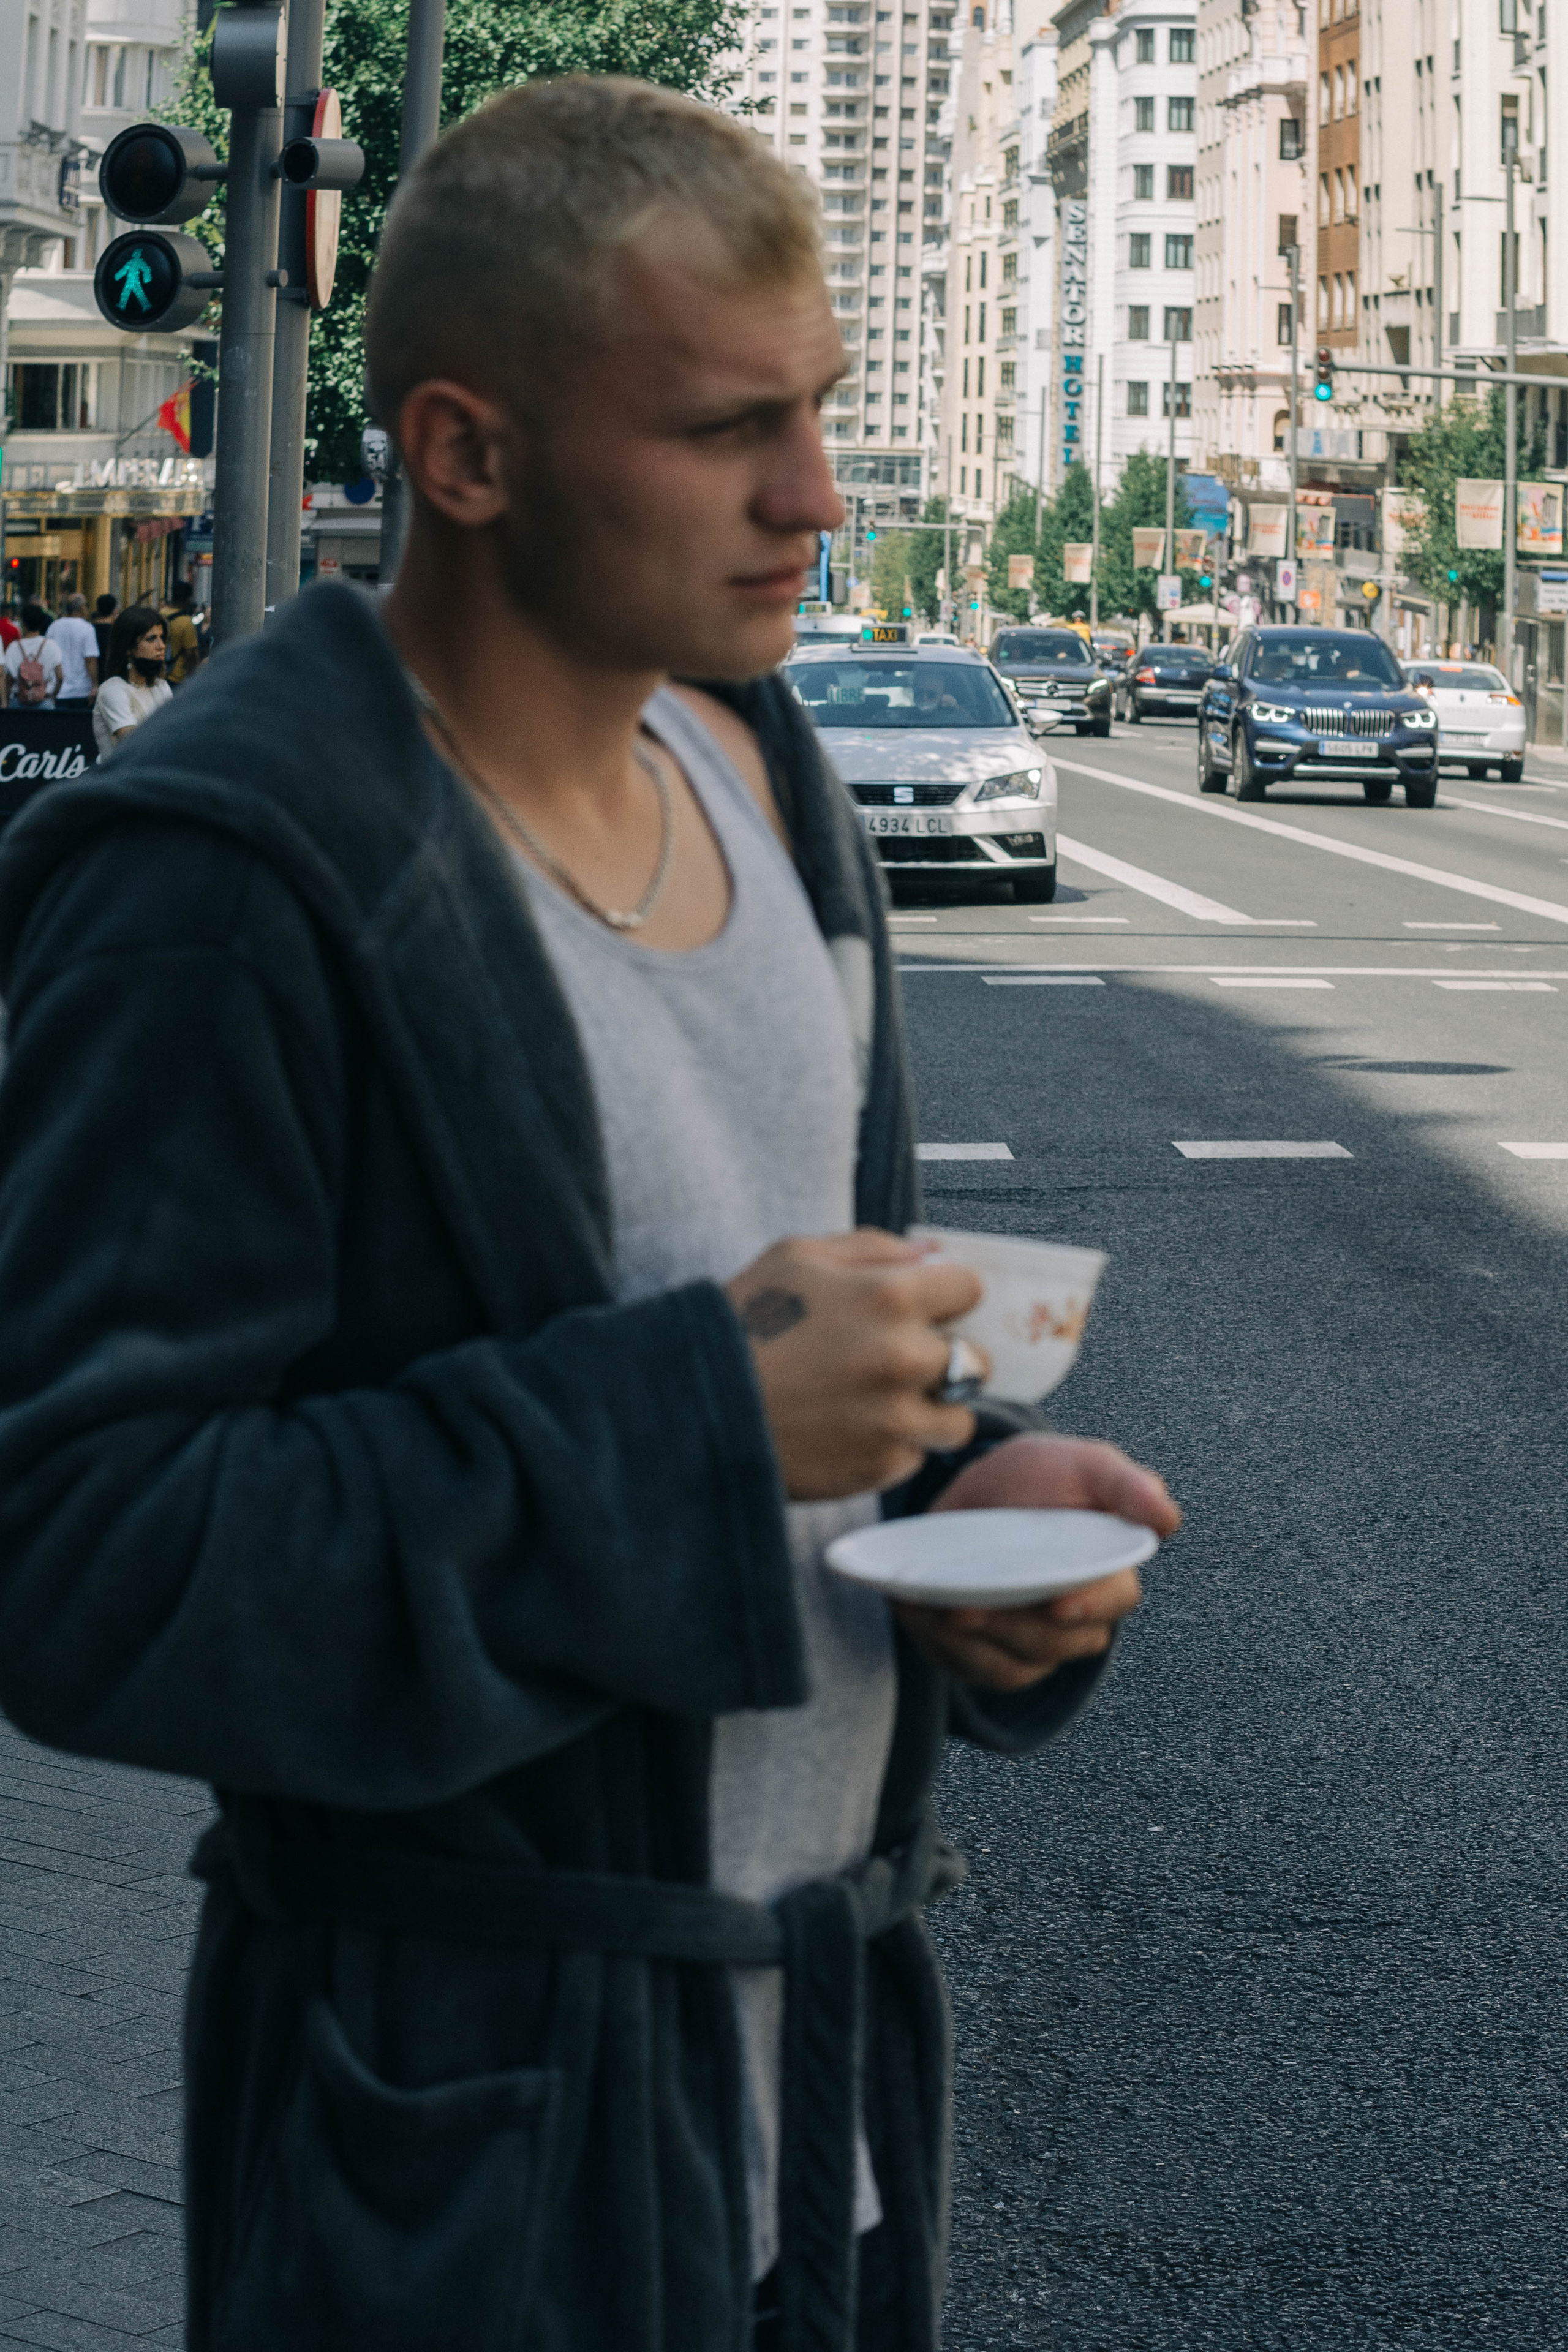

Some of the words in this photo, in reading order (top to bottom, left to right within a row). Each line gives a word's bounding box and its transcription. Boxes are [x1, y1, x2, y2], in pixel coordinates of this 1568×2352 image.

[1063, 203, 1087, 347] SENATOR
[1063, 355, 1083, 467] HOTEL
[872, 628, 897, 641] TAXI
[0, 743, 90, 782] Carl's
[869, 818, 910, 832] 4934
[916, 819, 947, 833] LCL
